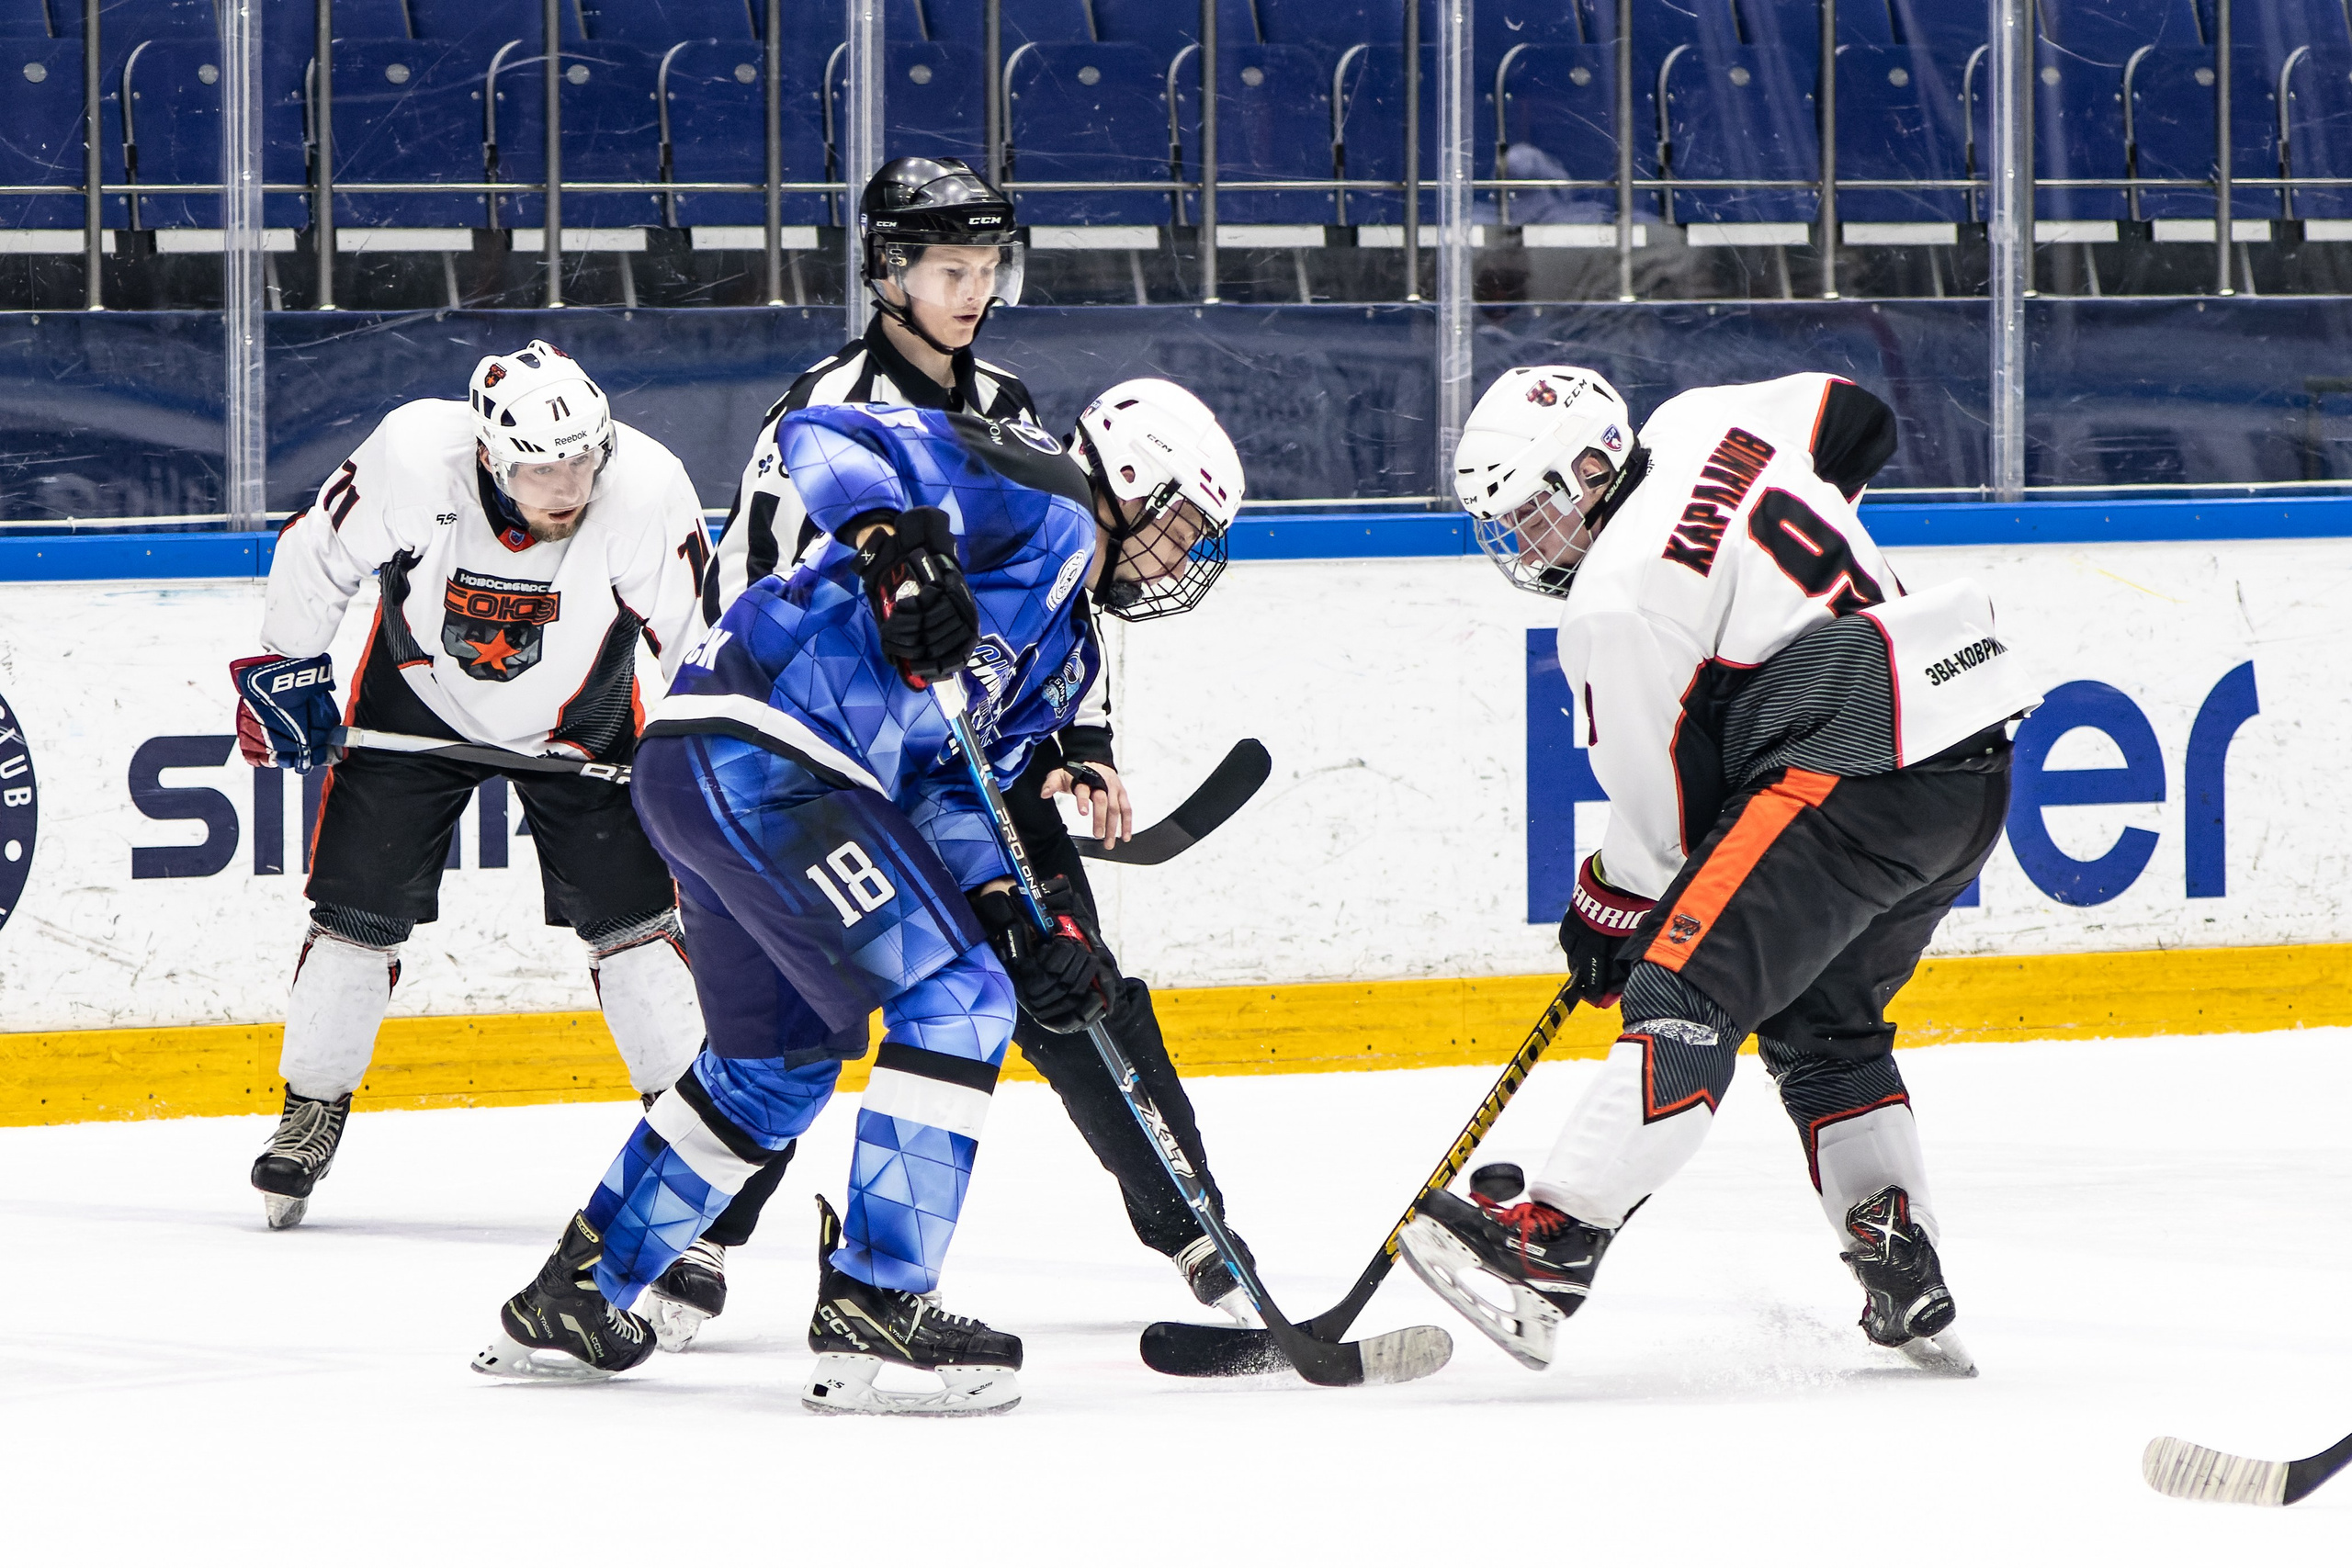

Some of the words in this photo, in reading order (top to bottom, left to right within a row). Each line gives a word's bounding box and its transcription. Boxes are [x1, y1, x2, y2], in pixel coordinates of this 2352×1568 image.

[968, 216, 1002, 225] CCM
[1563, 378, 1588, 408] CCM
[545, 396, 571, 422] 71
[554, 430, 588, 446] Reebok
[1147, 434, 1173, 453] CCM
[1604, 468, 1628, 502] BAUER
[1463, 495, 1477, 505] CM
[1747, 486, 1886, 620] 9
[459, 573, 550, 593] НОВОСИБИРС
[996, 807, 1025, 861] PRO
[1021, 864, 1043, 900] ONE
[805, 840, 896, 929] 18
[1385, 998, 1571, 1263] ERWOOD
[575, 1218, 597, 1241] CCM
[819, 1304, 870, 1352] CCM
[591, 1336, 605, 1358] CCM
